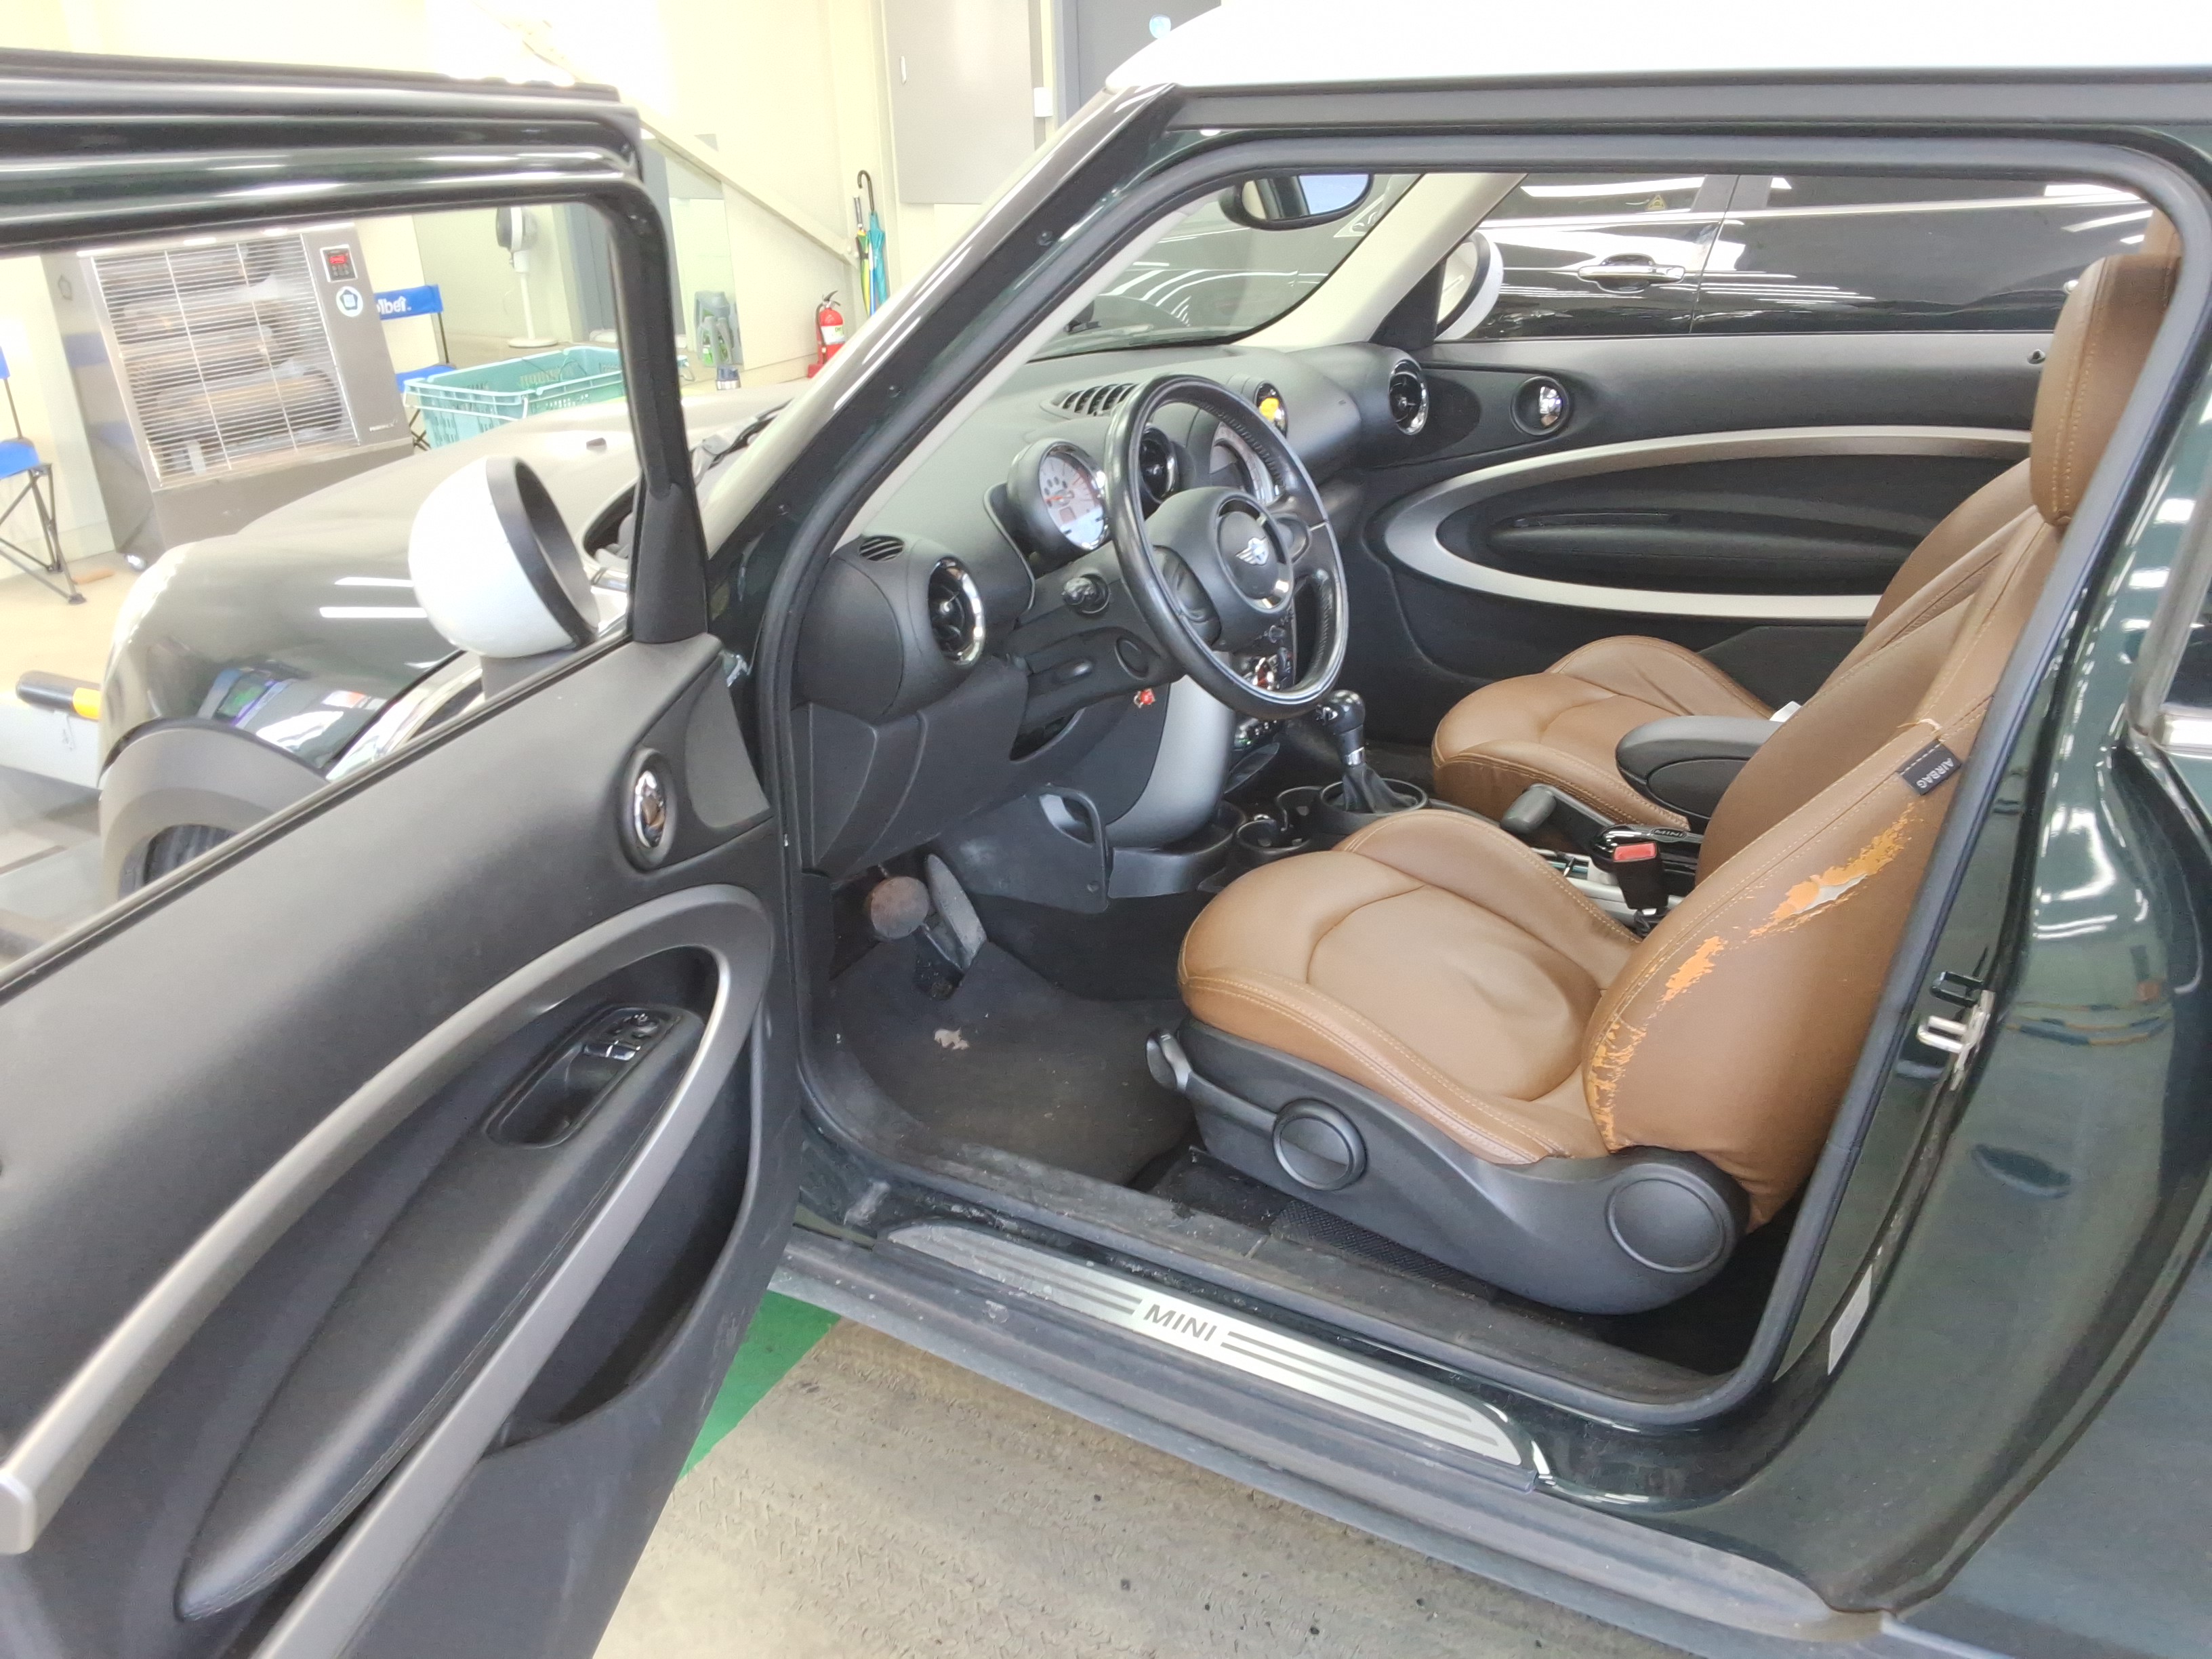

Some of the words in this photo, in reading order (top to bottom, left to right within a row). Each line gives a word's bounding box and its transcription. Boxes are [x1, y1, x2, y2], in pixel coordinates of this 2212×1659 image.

[1916, 758, 1954, 788] AIRBAG
[1654, 830, 1683, 838] MINI
[1143, 1303, 1218, 1342] MINI
